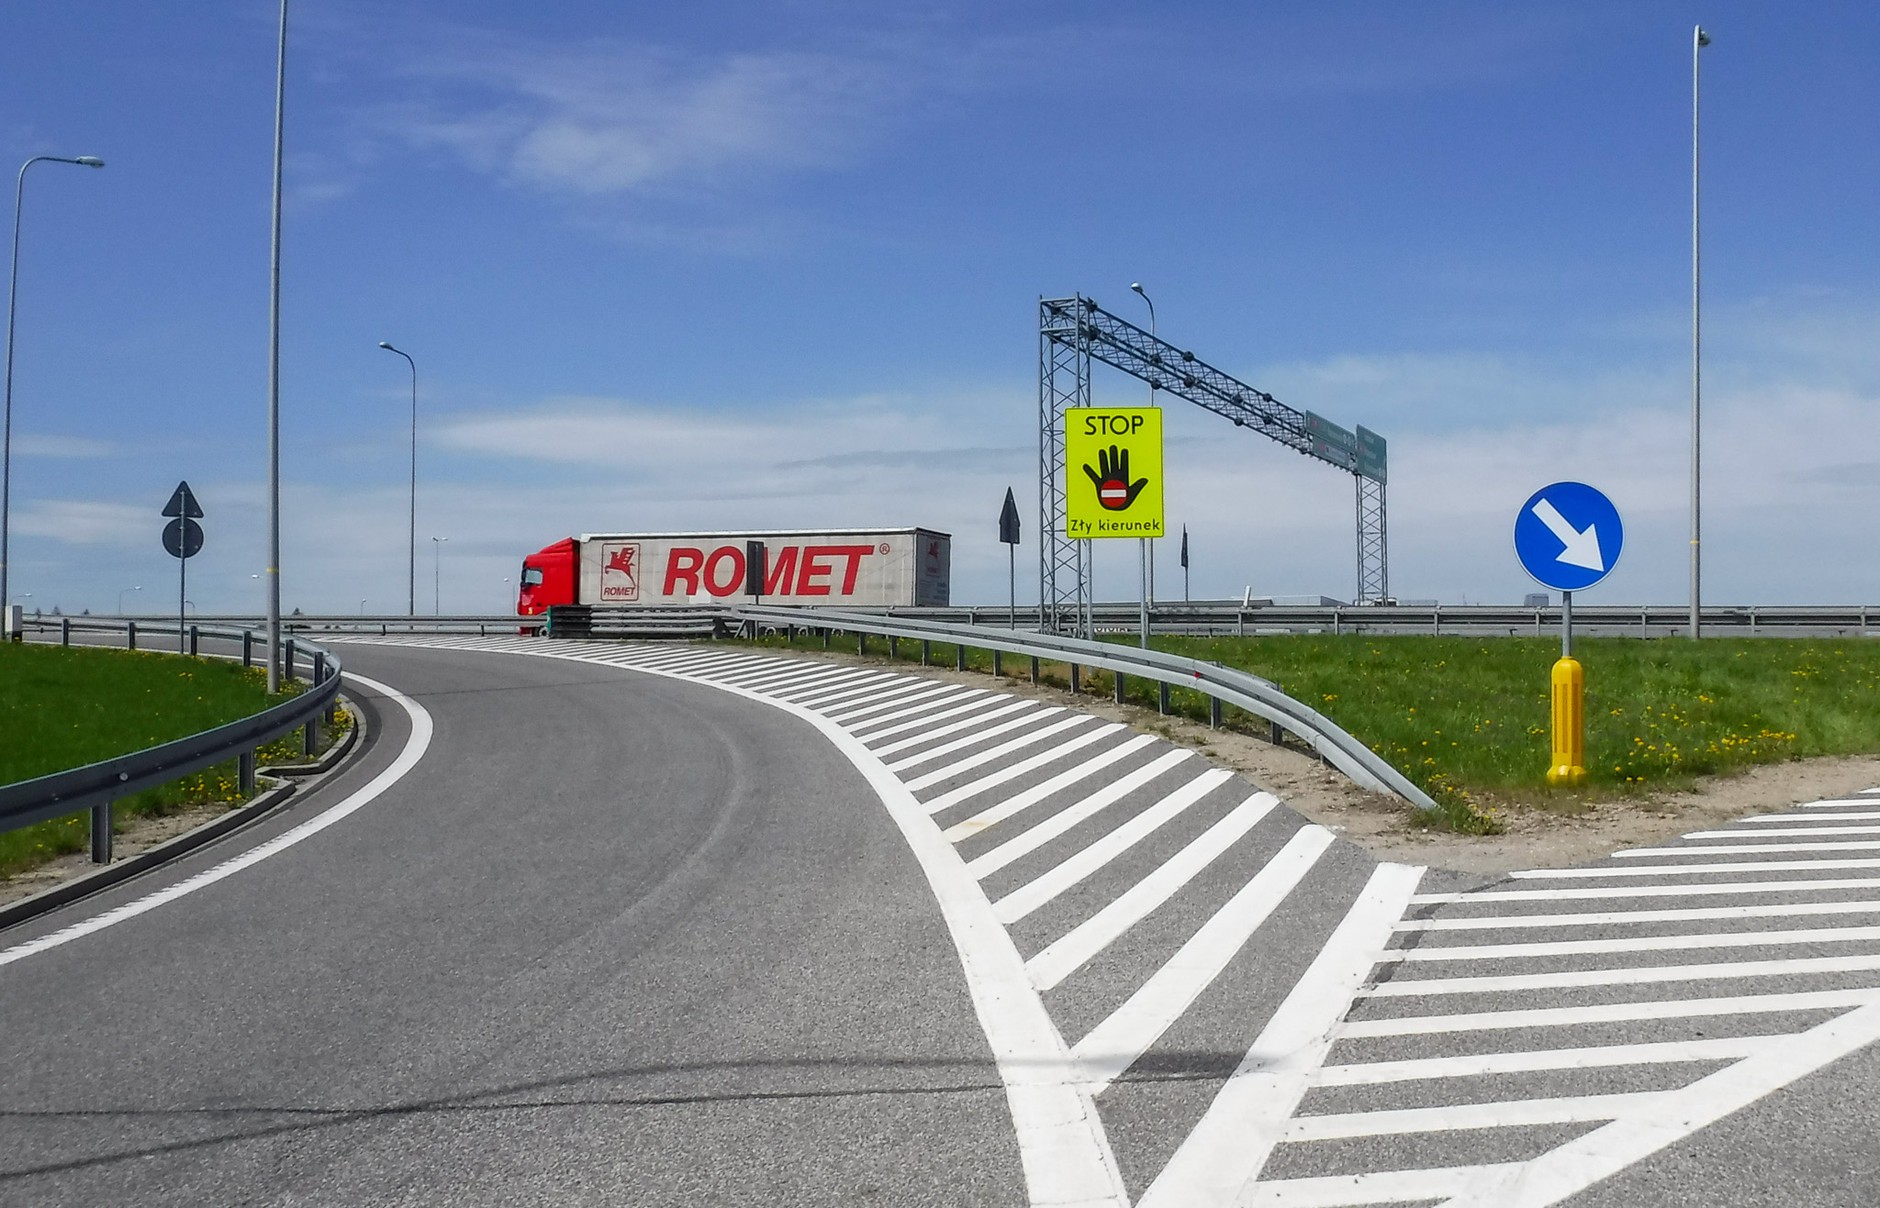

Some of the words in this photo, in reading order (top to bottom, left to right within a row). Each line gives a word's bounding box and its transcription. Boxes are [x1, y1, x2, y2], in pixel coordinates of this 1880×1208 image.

[1085, 415, 1144, 435] STOP
[1070, 519, 1092, 534] Zły
[1099, 519, 1160, 531] kierunek
[662, 545, 875, 597] ROMET
[603, 586, 636, 596] ROMET
